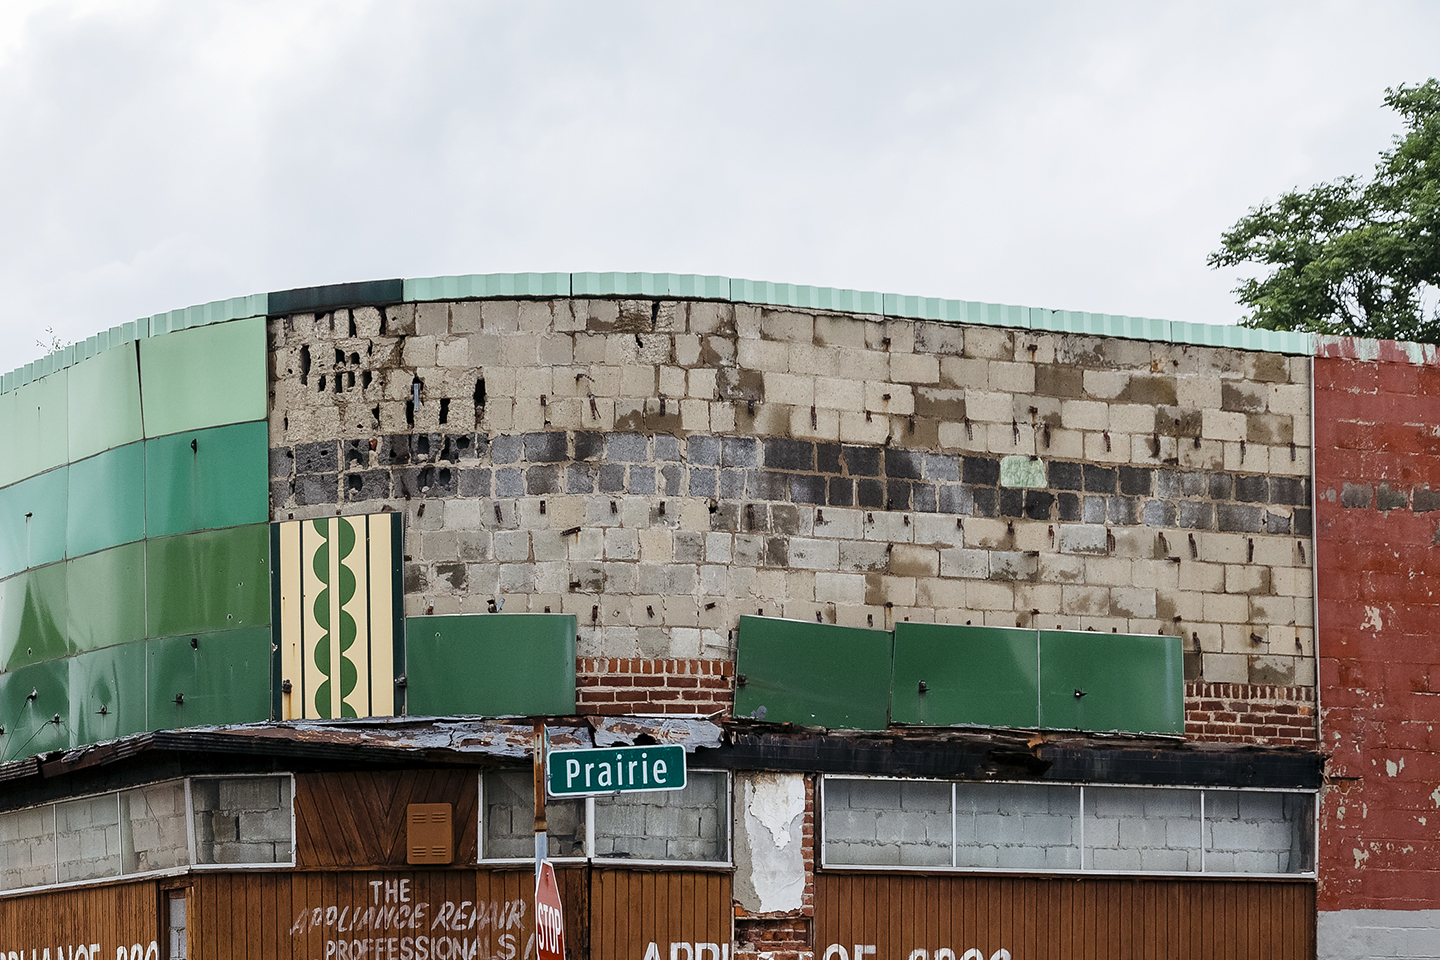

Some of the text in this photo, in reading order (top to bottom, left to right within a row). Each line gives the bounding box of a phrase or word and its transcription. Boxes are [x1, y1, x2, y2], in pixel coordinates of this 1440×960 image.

[566, 753, 667, 788] Prairie
[369, 878, 411, 905] THE
[289, 899, 527, 935] APPLIANCE REPAIR
[537, 902, 561, 955] STOP
